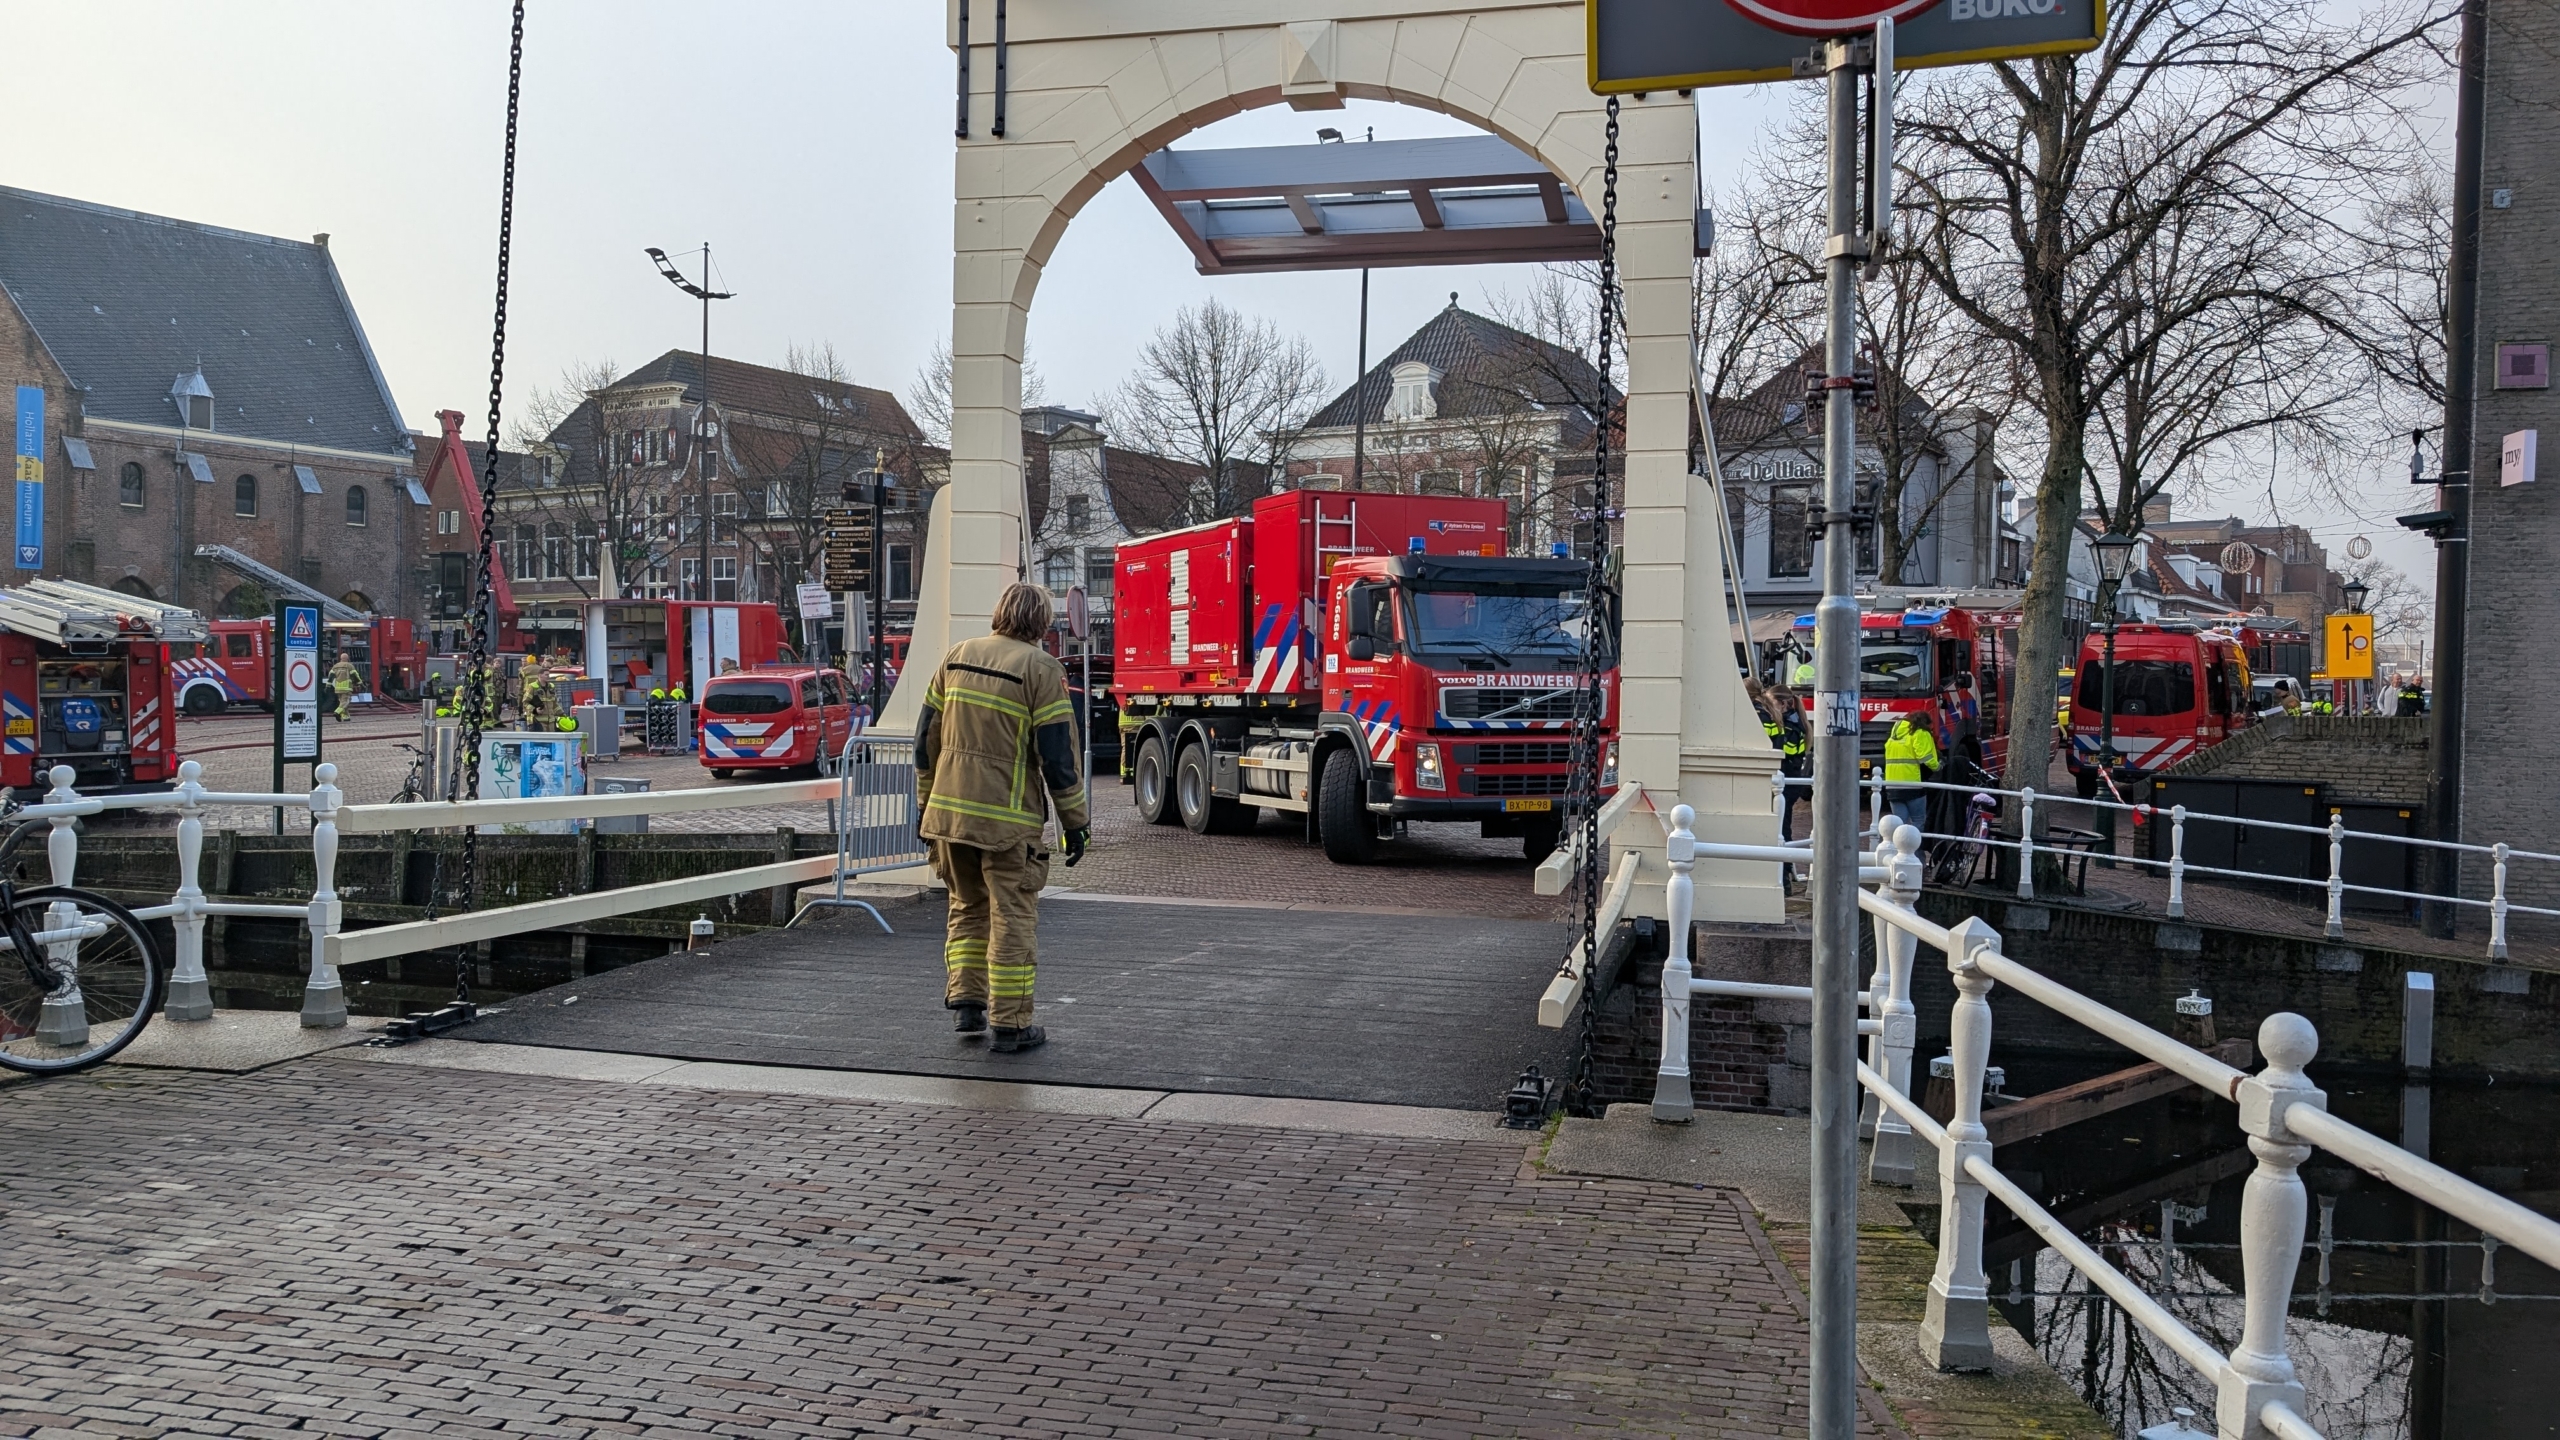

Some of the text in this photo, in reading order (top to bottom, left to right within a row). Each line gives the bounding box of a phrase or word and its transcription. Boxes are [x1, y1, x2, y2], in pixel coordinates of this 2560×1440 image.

[1333, 583, 1343, 641] 10-6686
[1345, 666, 1374, 674] BRANDWEER
[1476, 674, 1574, 686] BRANDWEER
[1509, 801, 1548, 811] BX-TP-98
